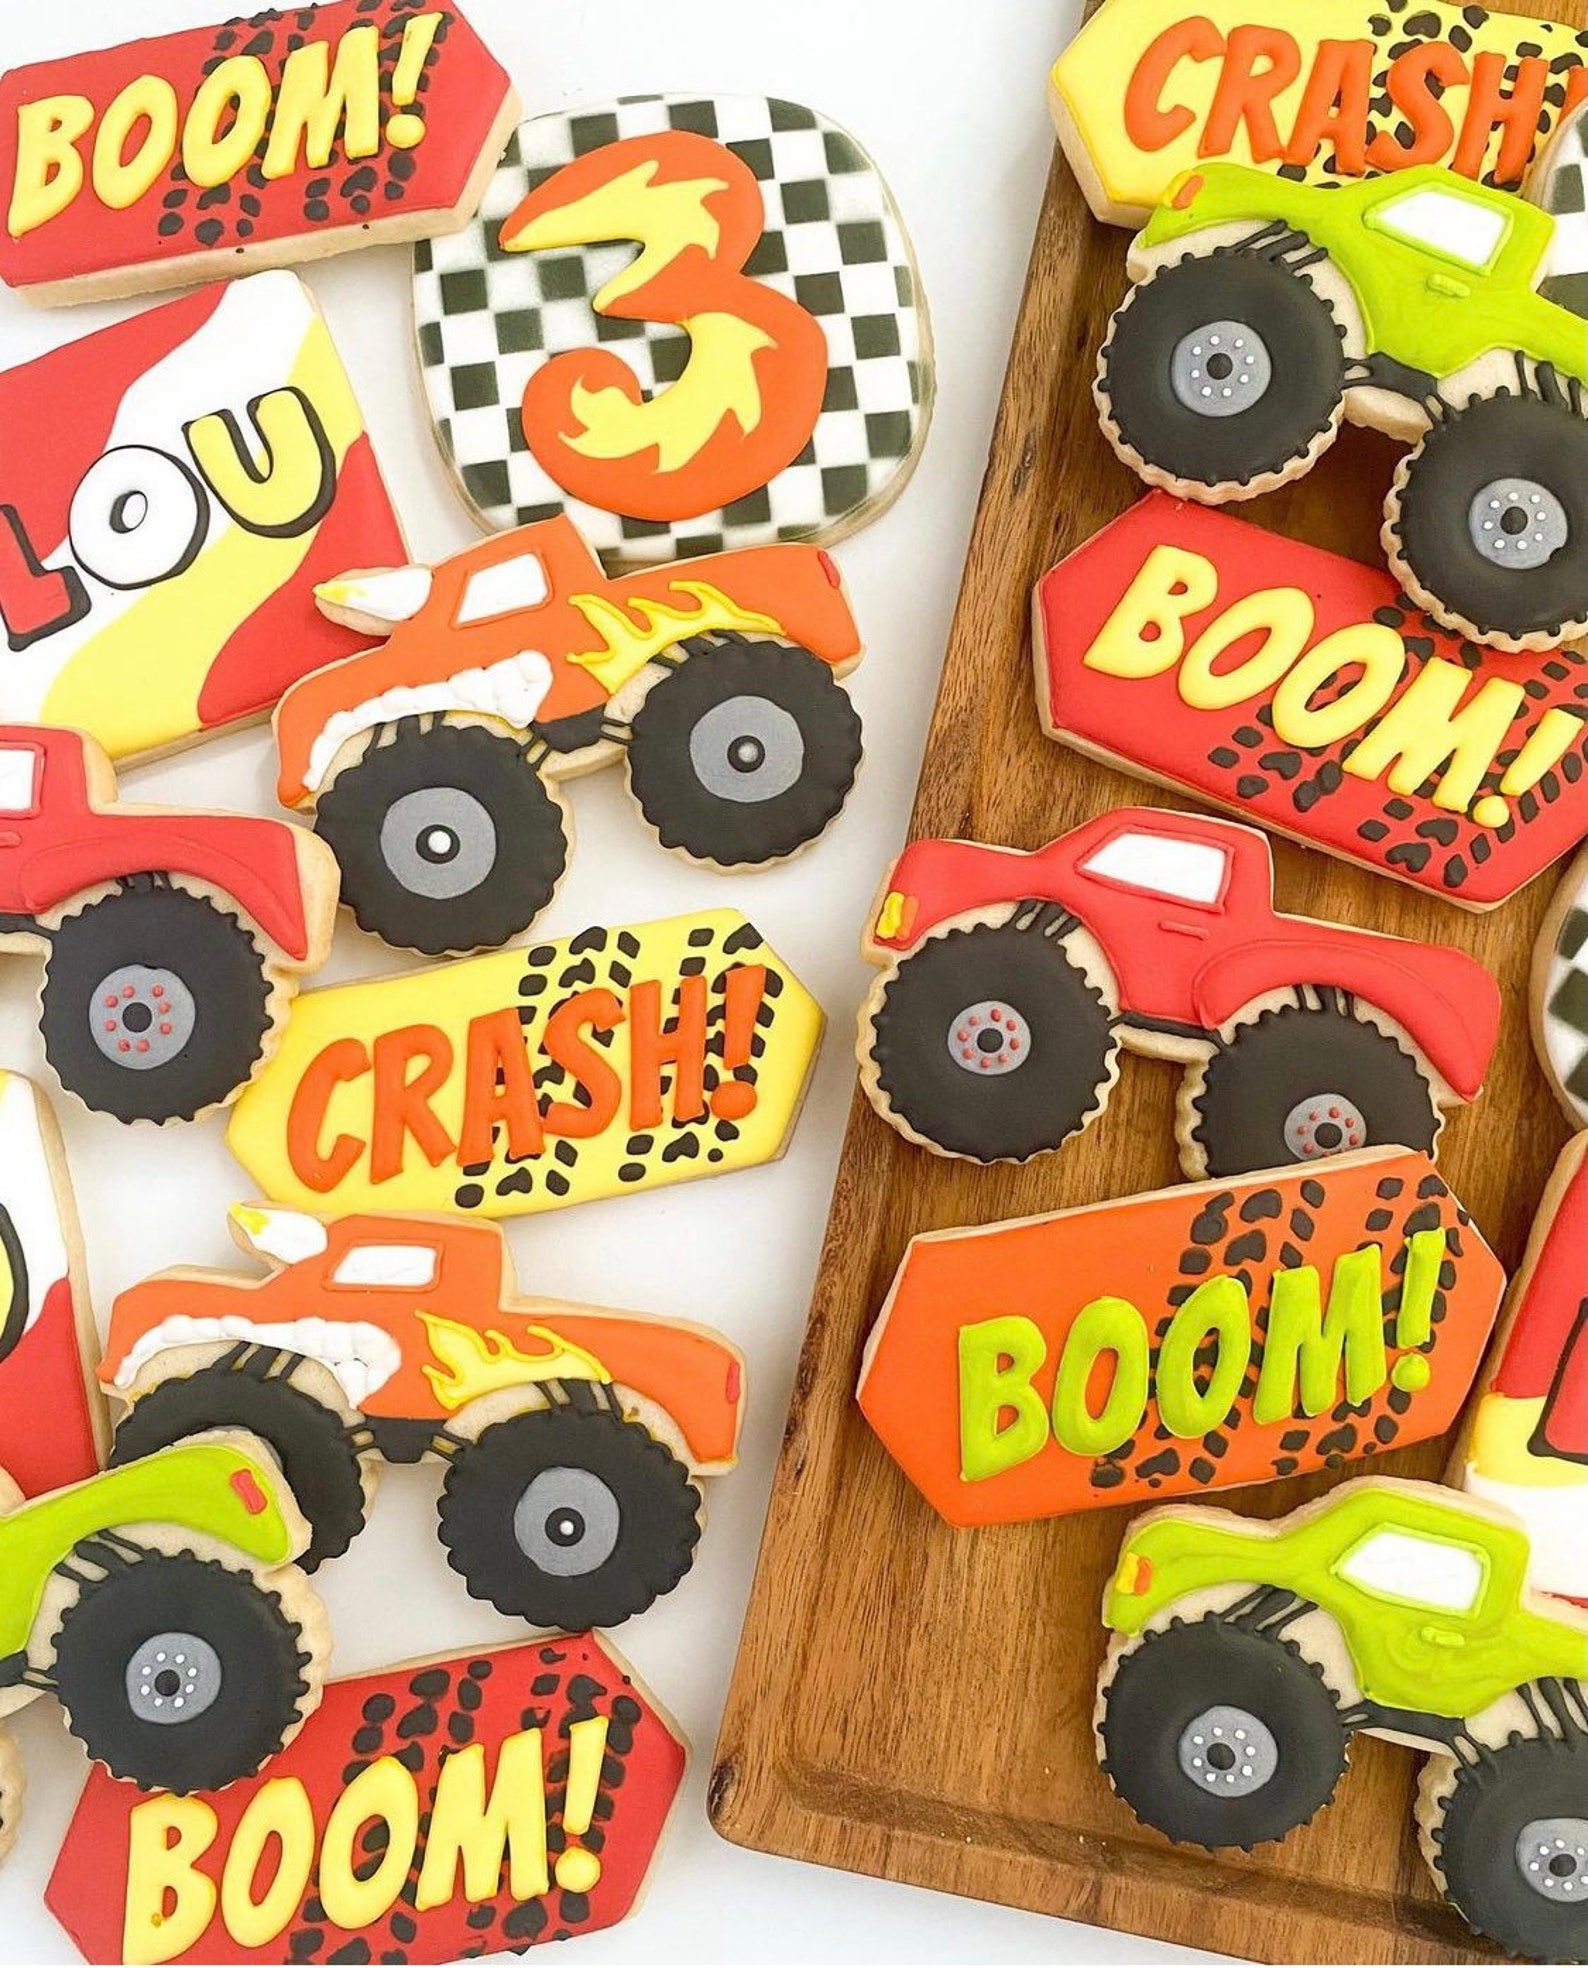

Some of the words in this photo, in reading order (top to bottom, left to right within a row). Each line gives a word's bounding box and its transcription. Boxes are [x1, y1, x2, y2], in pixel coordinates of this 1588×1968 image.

[8, 13, 442, 236] BOOM!
[1124, 15, 1588, 186] CRASH
[499, 130, 828, 522] 3
[1083, 544, 1584, 828] BOOM!
[287, 964, 766, 1193] CRASH!
[959, 1227, 1446, 1482] BOOM!
[122, 1715, 609, 1965] BOOM!
